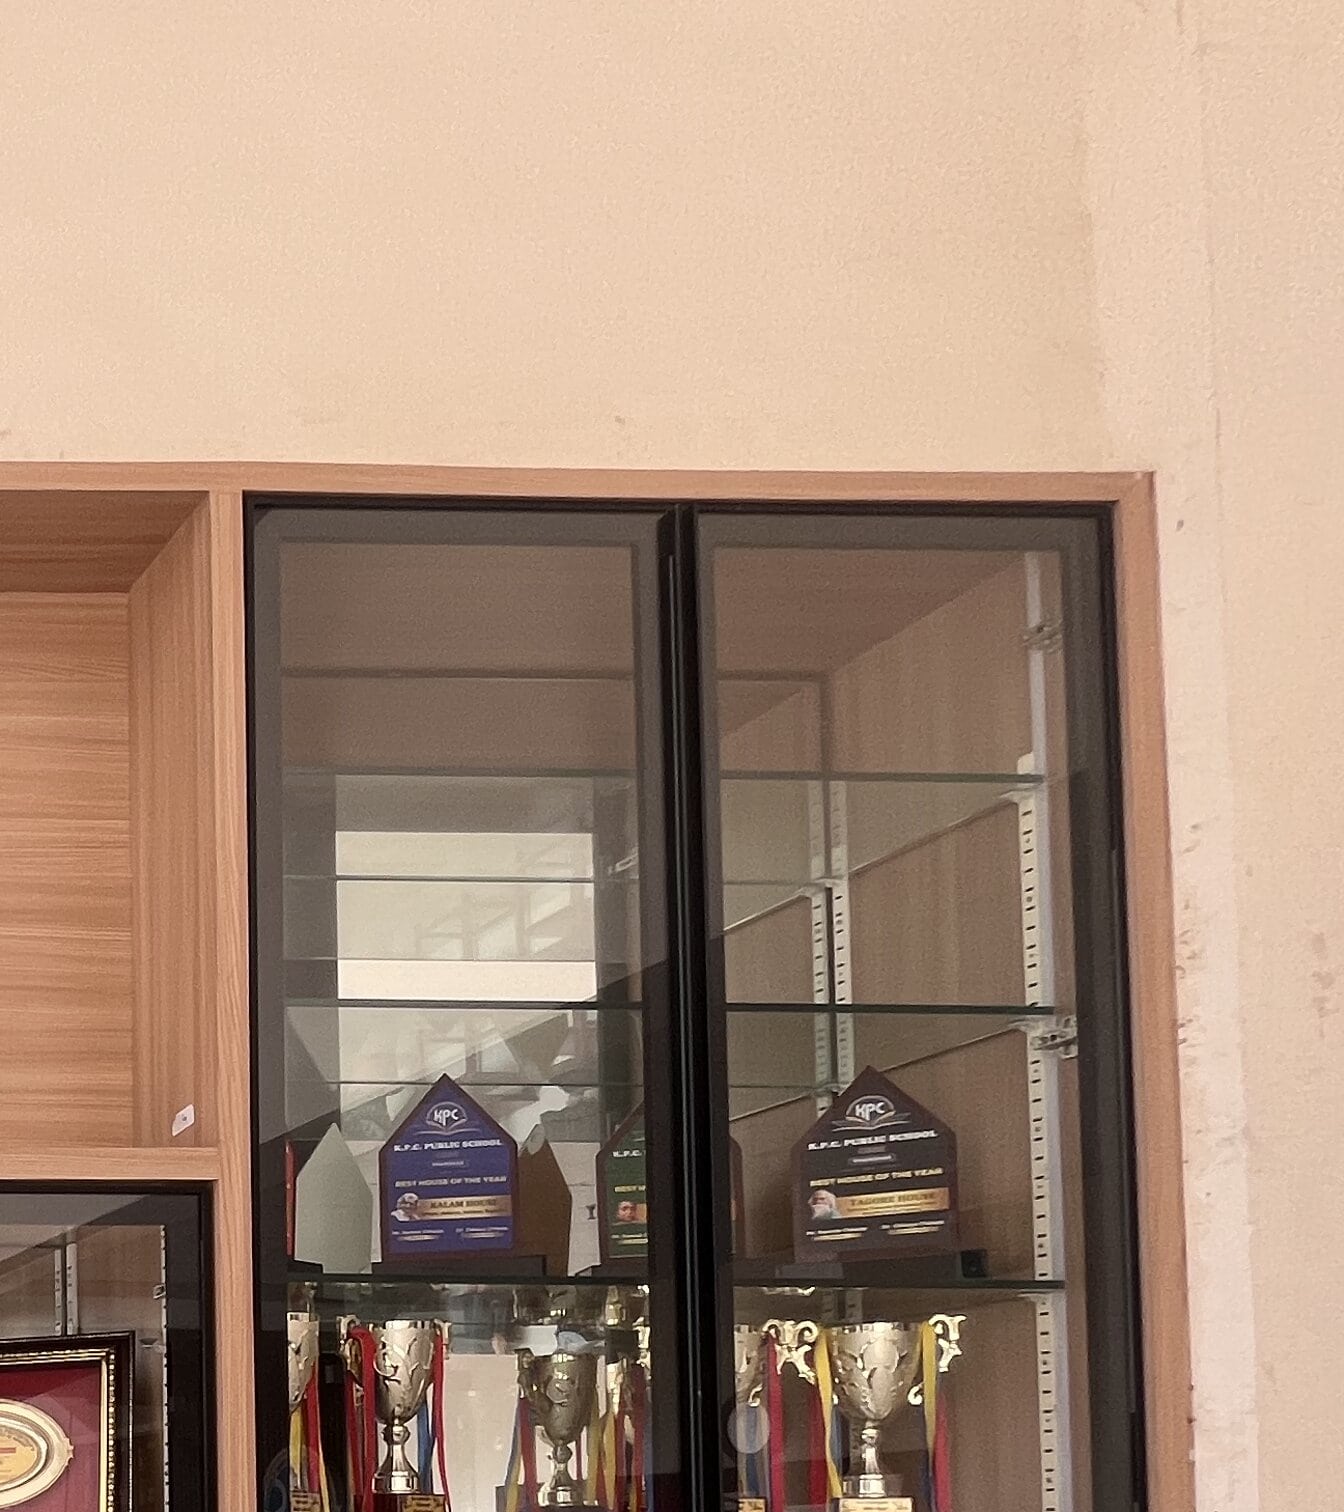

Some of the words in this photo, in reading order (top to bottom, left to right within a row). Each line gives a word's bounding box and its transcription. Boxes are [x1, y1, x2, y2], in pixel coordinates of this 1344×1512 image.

[433, 1108, 459, 1126] KPC
[855, 1102, 885, 1120] KPC
[424, 1141, 460, 1150] PUBLIC
[462, 1139, 502, 1148] SCHOOL
[843, 1135, 886, 1147] PUBLIC
[889, 1130, 938, 1142] SCHOOL
